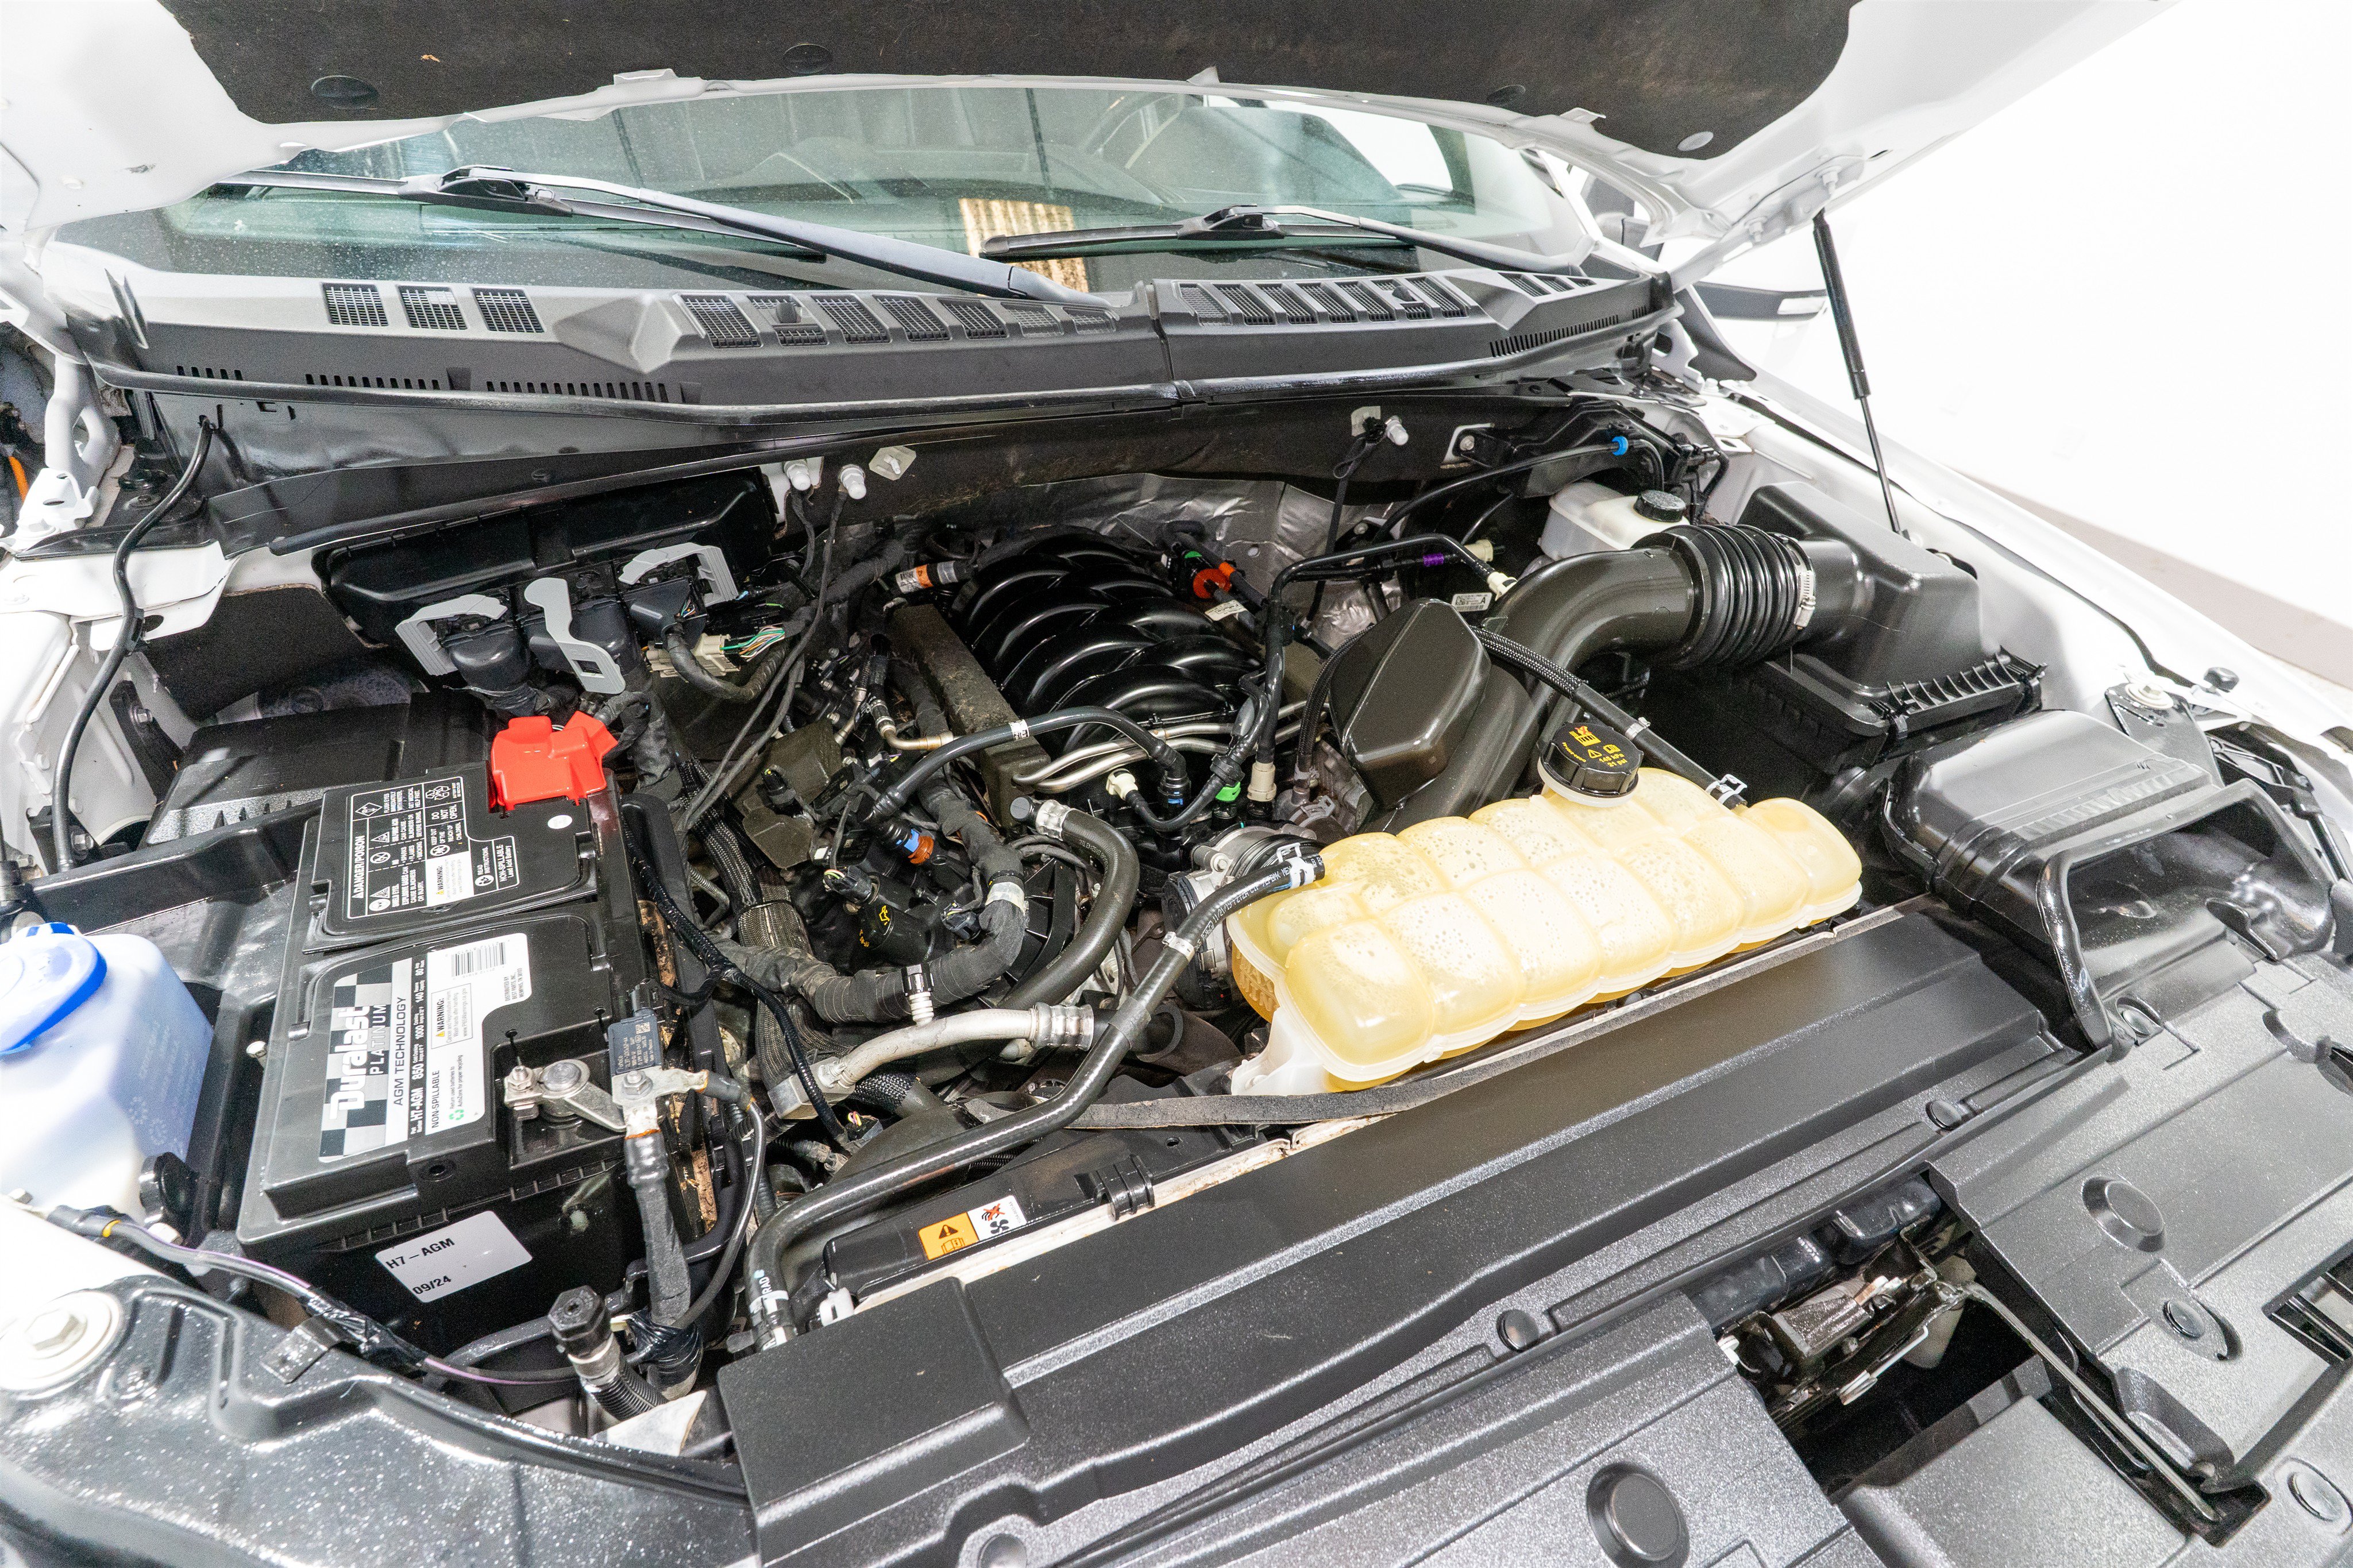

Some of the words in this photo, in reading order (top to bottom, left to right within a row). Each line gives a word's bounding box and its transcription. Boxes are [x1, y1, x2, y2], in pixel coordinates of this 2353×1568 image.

[431, 811, 439, 820] DO
[440, 808, 449, 820] NOT
[449, 804, 457, 819] OPEN.
[353, 835, 365, 893] DANGER/POISON
[482, 845, 490, 874] INSTRUCTIONS.
[496, 844, 507, 882] NON-SPILLABLE
[418, 893, 424, 901] OR
[415, 968, 423, 976] 80
[415, 991, 424, 1003] 140
[436, 997, 445, 1032] WARNING:
[369, 1004, 387, 1075] PLATINUM
[395, 997, 406, 1074] TECHNOLOGY
[415, 1024, 424, 1040] 1000
[330, 1006, 370, 1119] Duralast
[411, 1063, 423, 1080] 850
[394, 1077, 403, 1107] AGM
[430, 1069, 440, 1128] NON-SPILLABLE
[412, 1276, 452, 1295] 09/24
[759, 1276, 773, 1295] RAD
